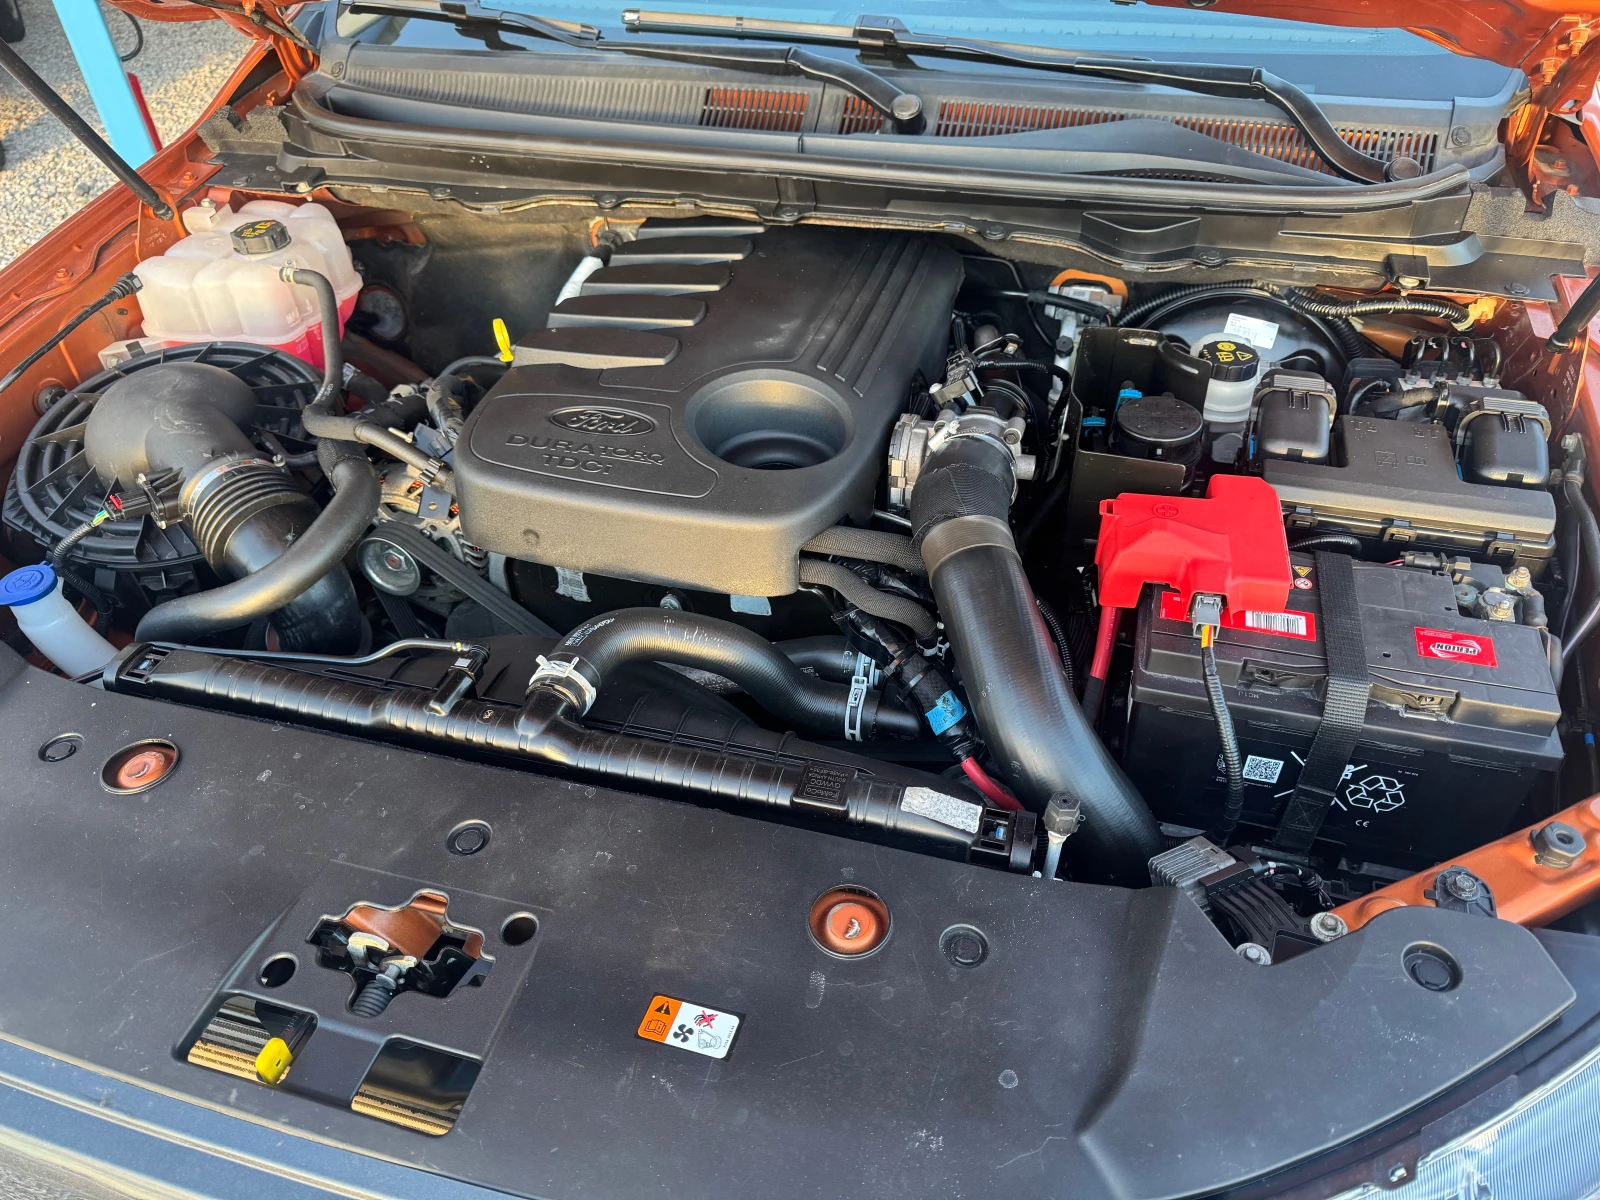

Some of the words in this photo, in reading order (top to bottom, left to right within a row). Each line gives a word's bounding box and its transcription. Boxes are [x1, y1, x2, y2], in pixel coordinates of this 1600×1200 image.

[566, 410, 638, 434] Ford
[542, 454, 613, 475] TDCi
[1436, 643, 1477, 655] PERION
[808, 772, 828, 780] AFRICA
[807, 787, 838, 799] FoMoCo
